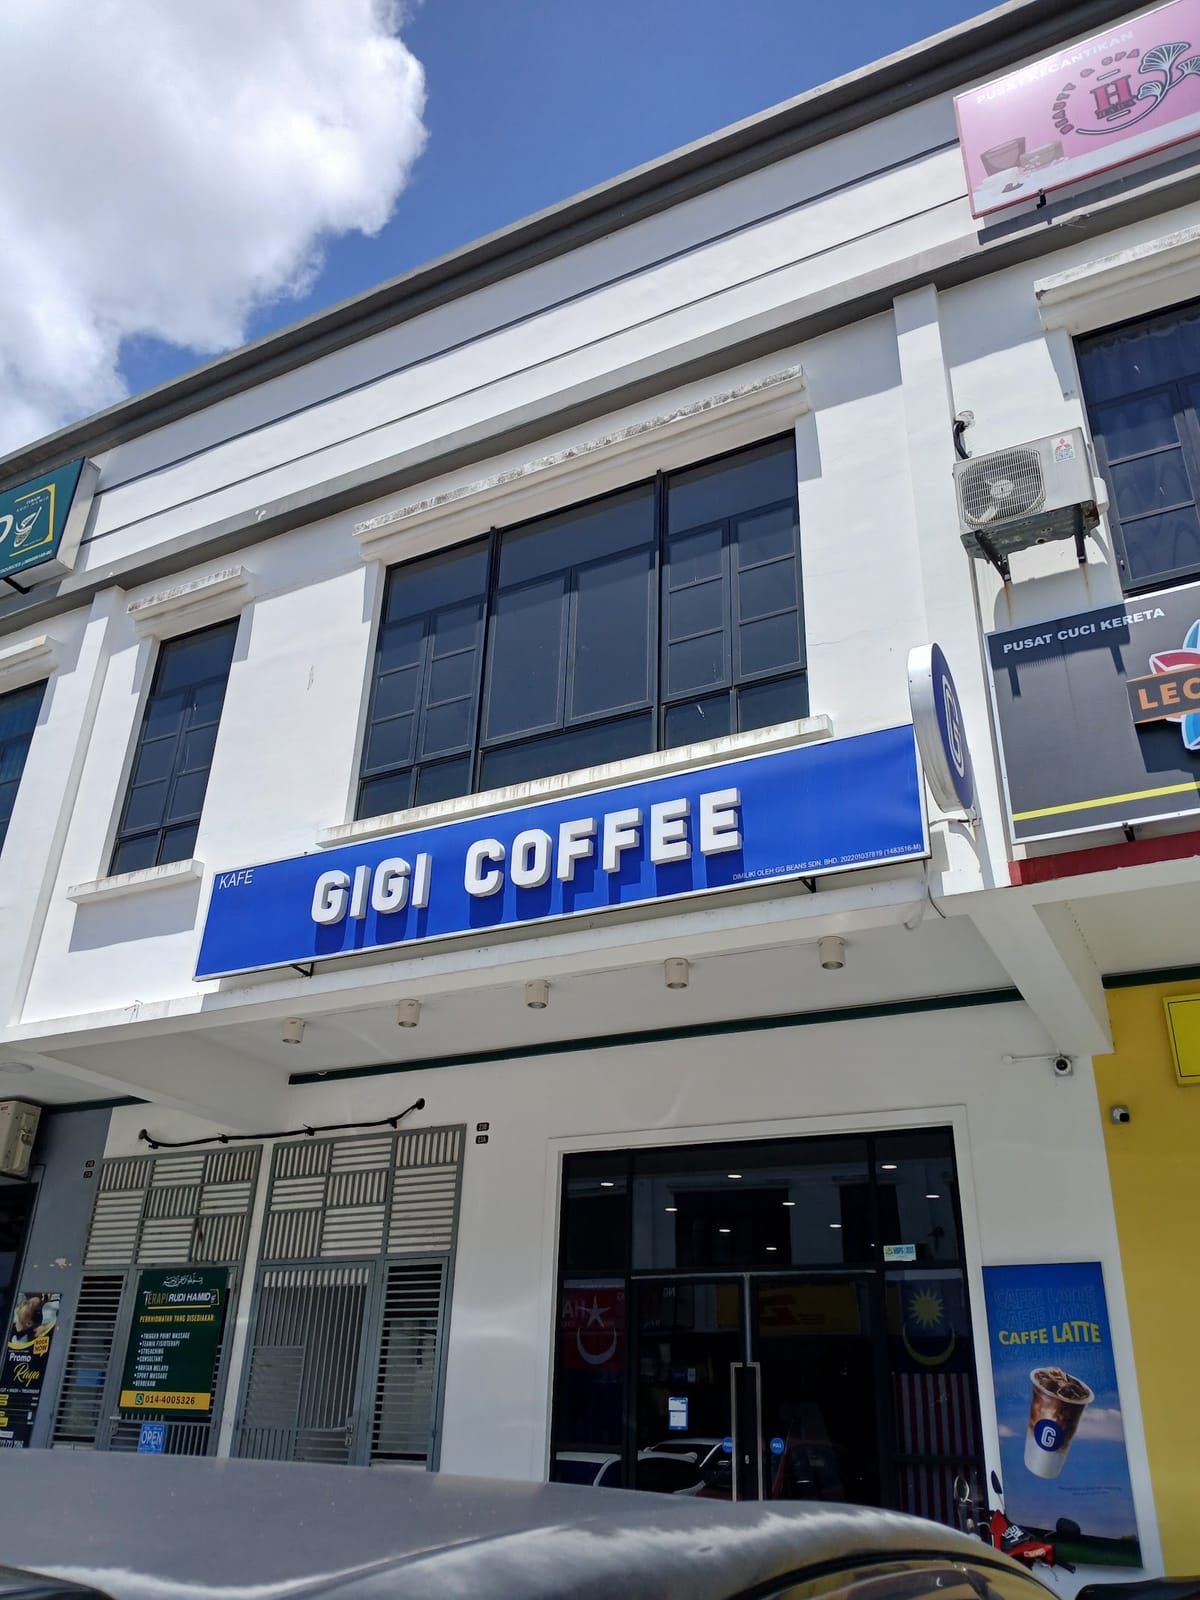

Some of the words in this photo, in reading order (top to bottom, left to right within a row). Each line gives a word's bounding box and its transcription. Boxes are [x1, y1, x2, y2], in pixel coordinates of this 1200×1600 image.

[1003, 634, 1053, 654] PUSAT
[1057, 623, 1096, 641] CUCI
[1100, 607, 1165, 631] KERETA
[311, 853, 432, 925] GIGI
[464, 787, 742, 897] COFFEE
[786, 862, 807, 872] BEANS
[219, 869, 255, 889] KAFE
[998, 1328, 1048, 1345] CAFFE
[1052, 1320, 1101, 1344] LATTE
[9, 1352, 31, 1362] Promo
[142, 1430, 161, 1445] OPEN
[1042, 1426, 1057, 1448] G
